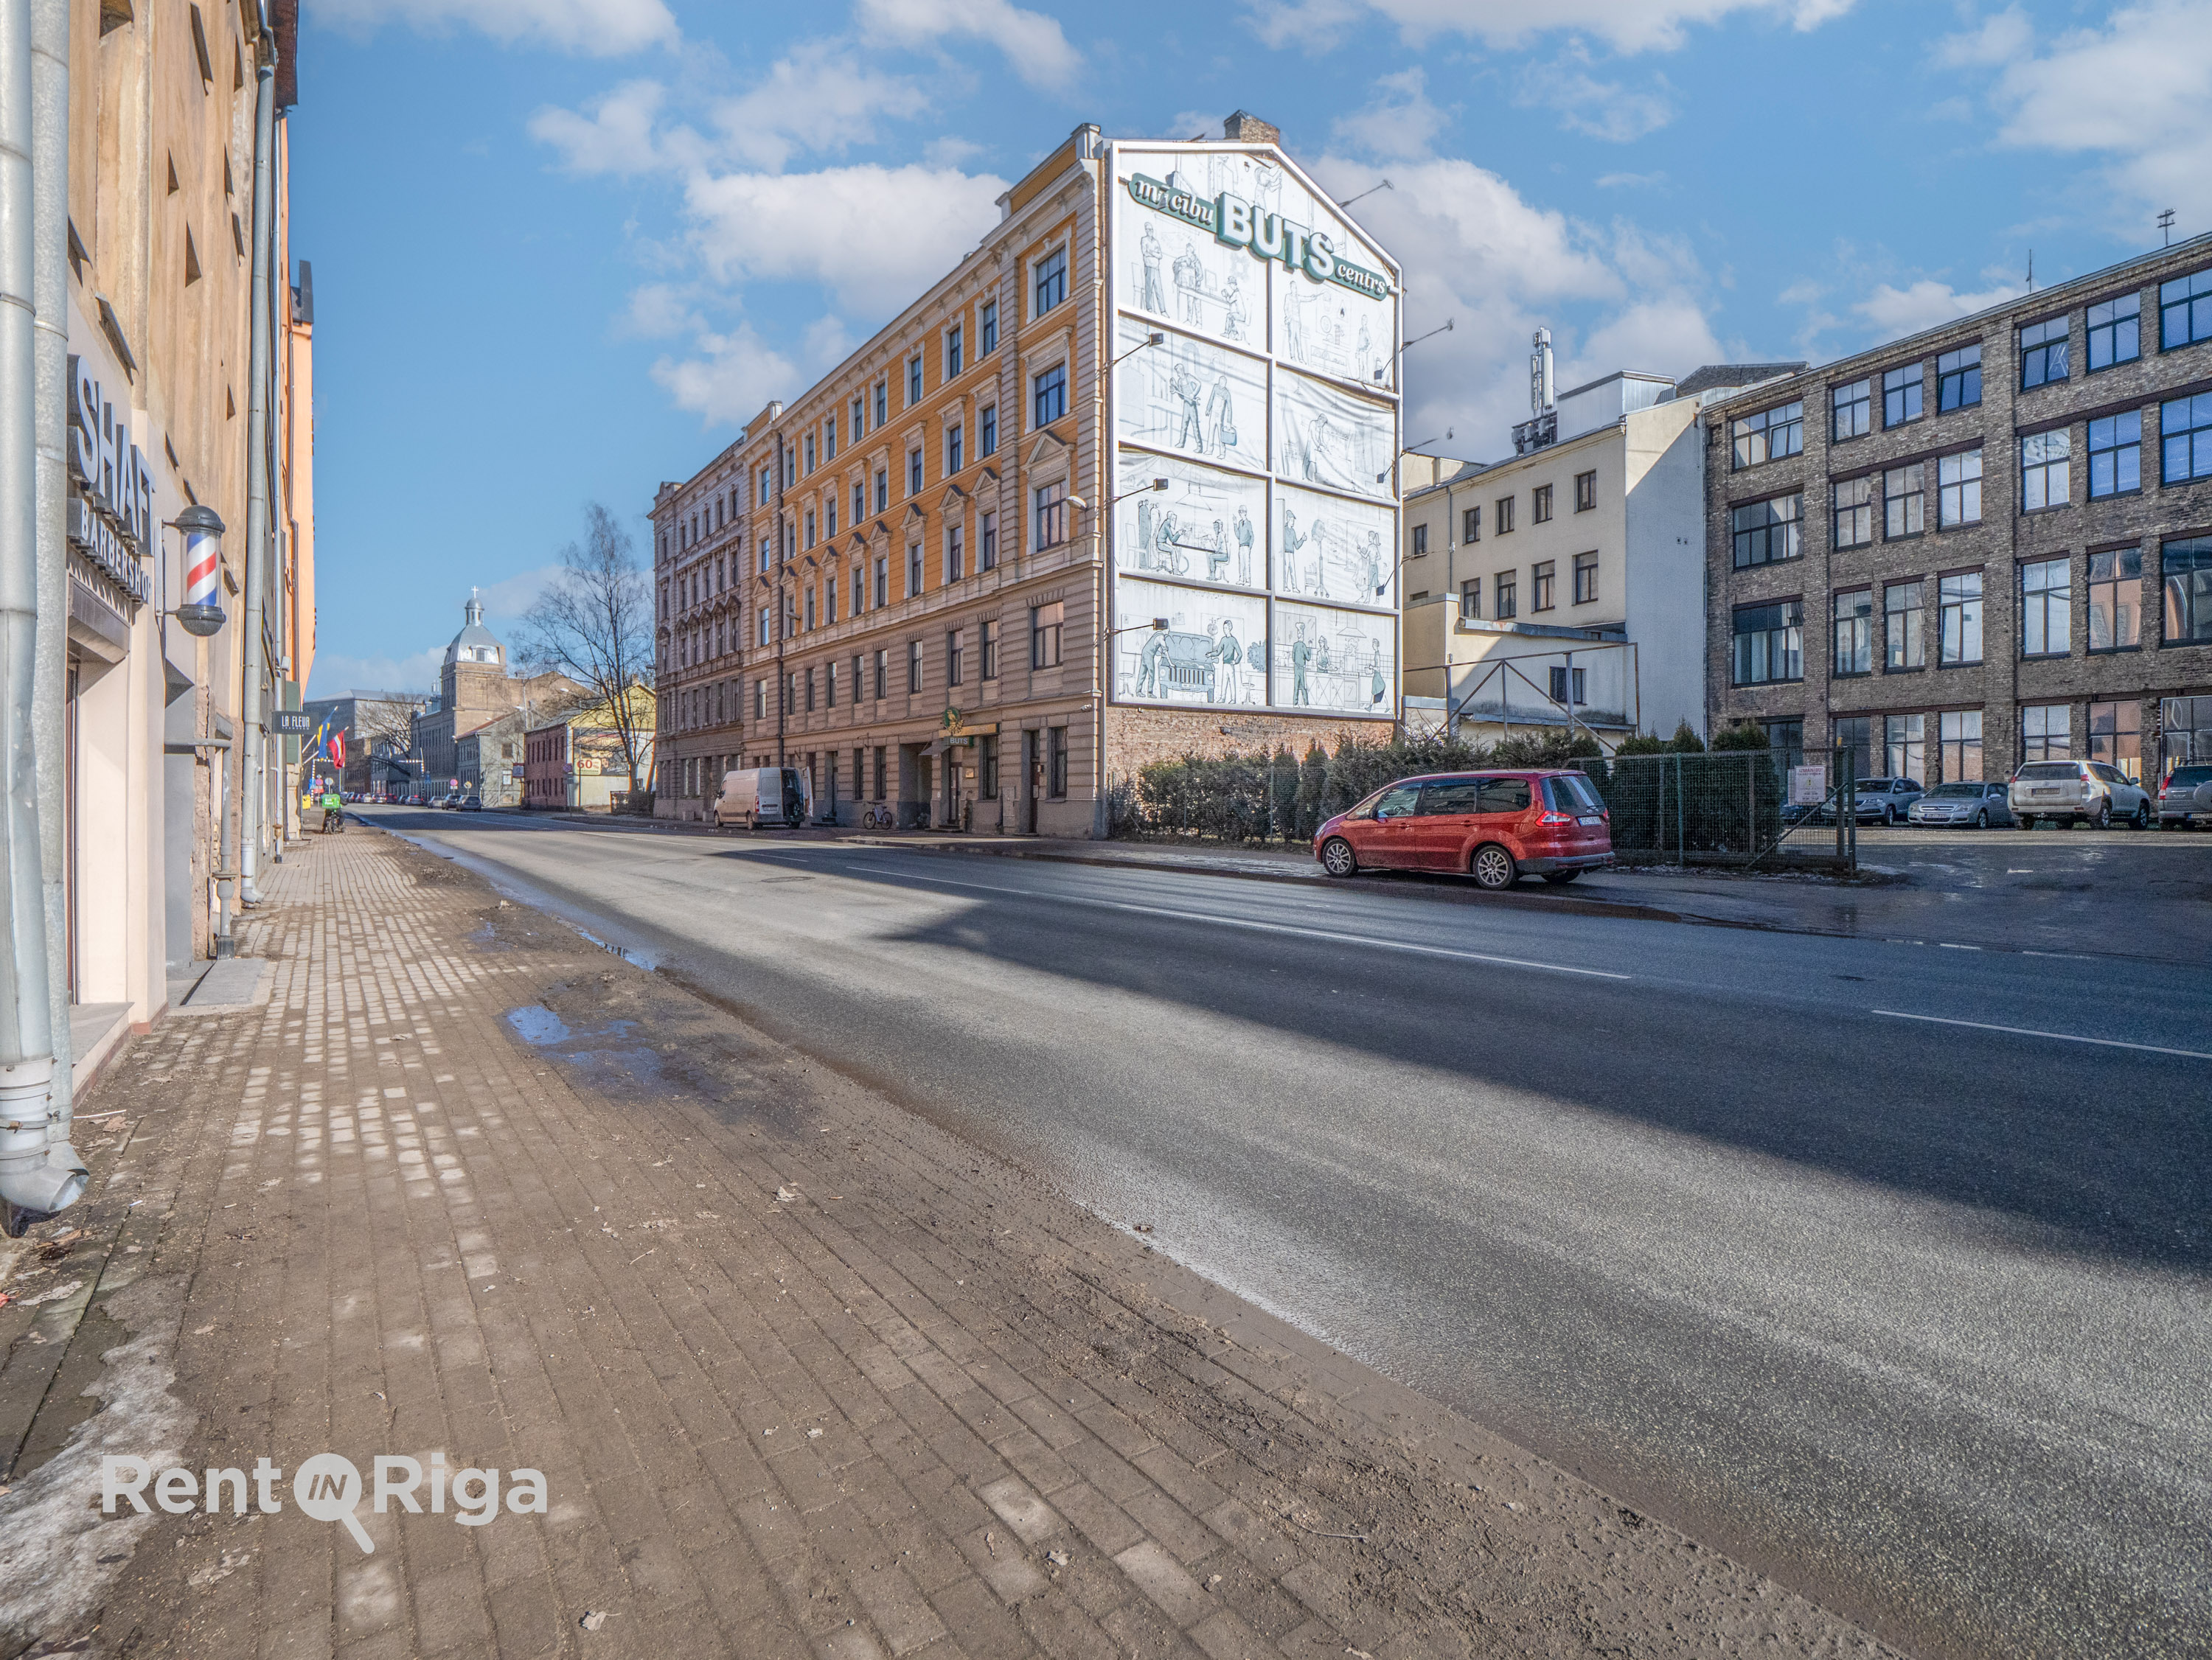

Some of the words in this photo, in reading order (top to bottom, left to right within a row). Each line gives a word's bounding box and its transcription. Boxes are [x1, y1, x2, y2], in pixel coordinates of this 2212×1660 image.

[1220, 192, 1335, 278] BUTS
[1337, 264, 1385, 294] centrs
[77, 355, 155, 557] SHAFT
[81, 498, 152, 601] BARBERSHOP
[282, 716, 289, 727] LA
[292, 716, 310, 728] FLEUR
